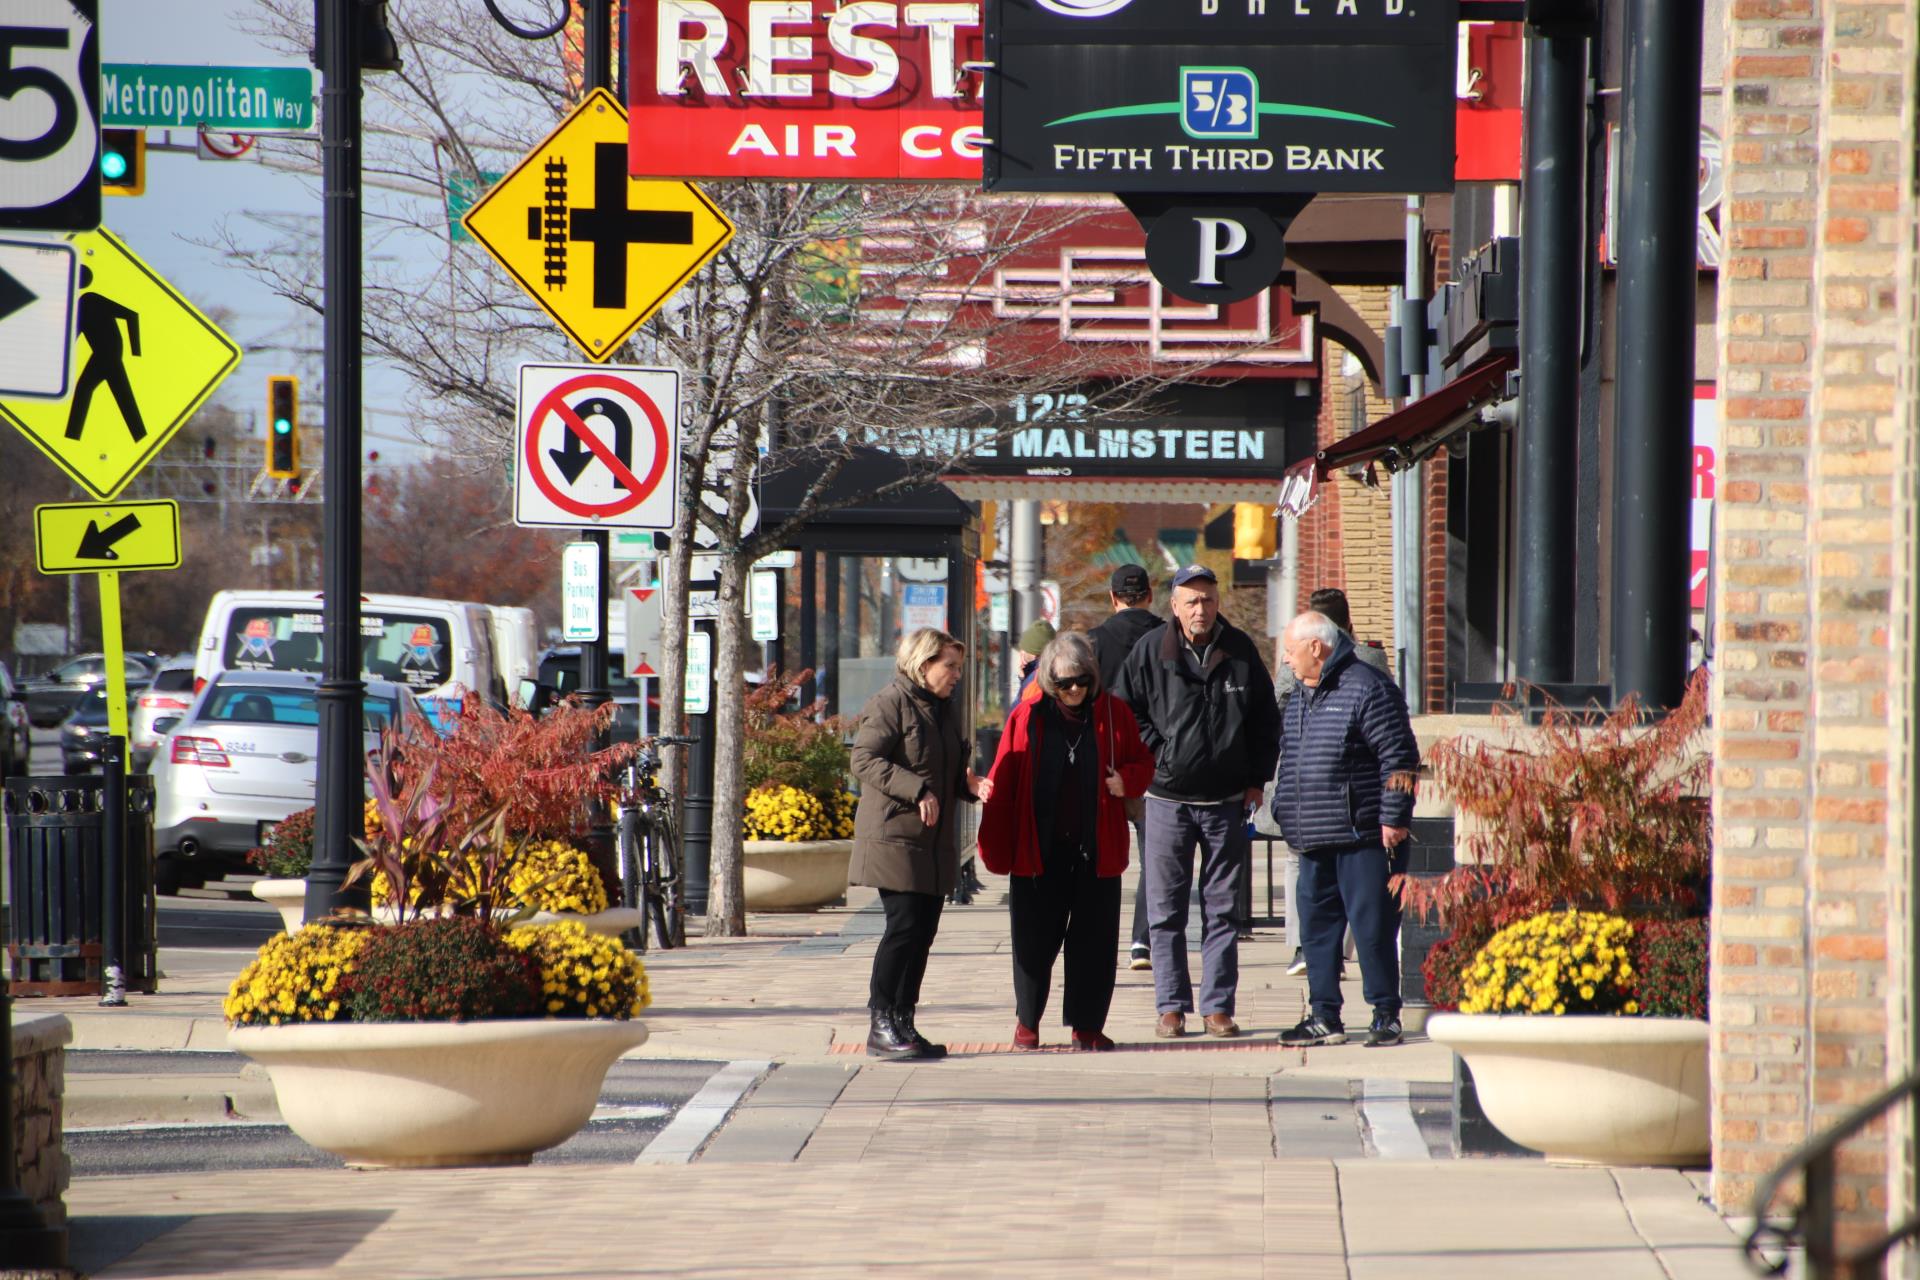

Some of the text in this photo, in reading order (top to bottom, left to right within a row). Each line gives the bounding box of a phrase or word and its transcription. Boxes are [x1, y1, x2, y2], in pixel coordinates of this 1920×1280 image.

[656, 0, 983, 98] REST
[102, 74, 304, 126] Metropolitan Way
[728, 123, 858, 158] AIR
[1053, 144, 1385, 171] FIFTH THIRD BANK
[1191, 217, 1248, 287] P
[1011, 428, 1265, 460] MALMSTEEN
[573, 561, 588, 576] Bus
[567, 582, 595, 601] Parking
[571, 603, 590, 621] Only
